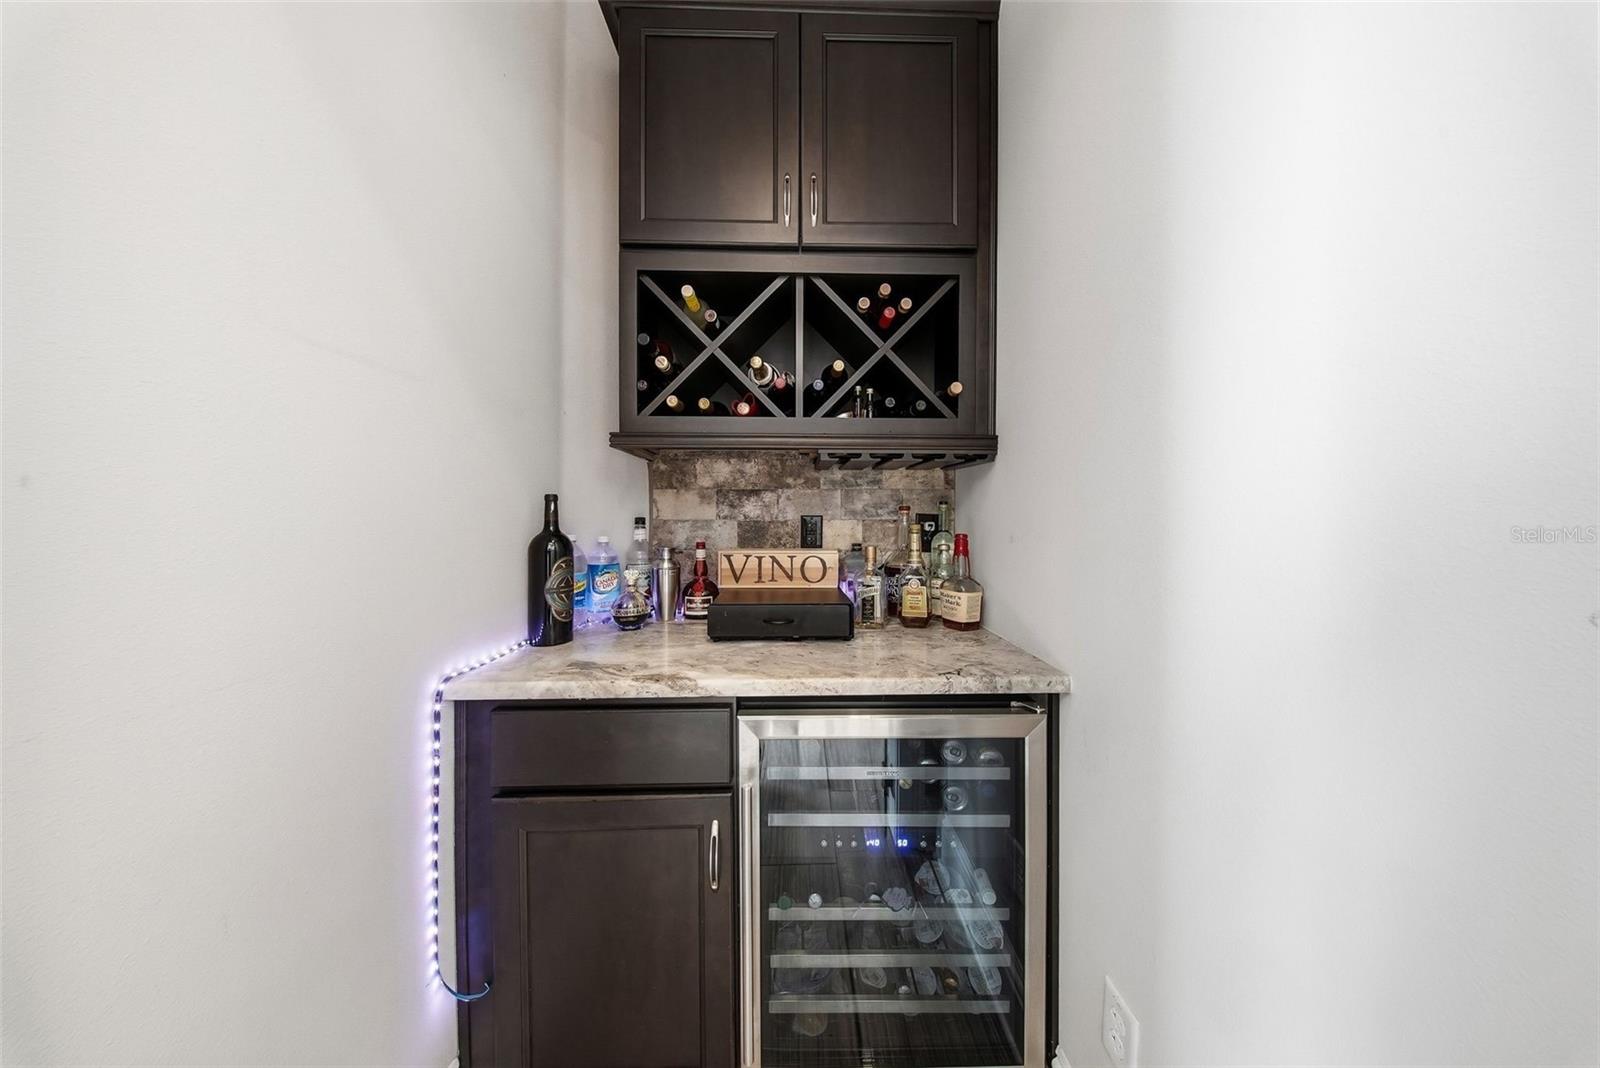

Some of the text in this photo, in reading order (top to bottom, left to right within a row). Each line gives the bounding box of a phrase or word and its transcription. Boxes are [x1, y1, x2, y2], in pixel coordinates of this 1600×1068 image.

[723, 554, 828, 584] VINO
[595, 573, 620, 588] CANADA
[603, 581, 616, 589] DRY
